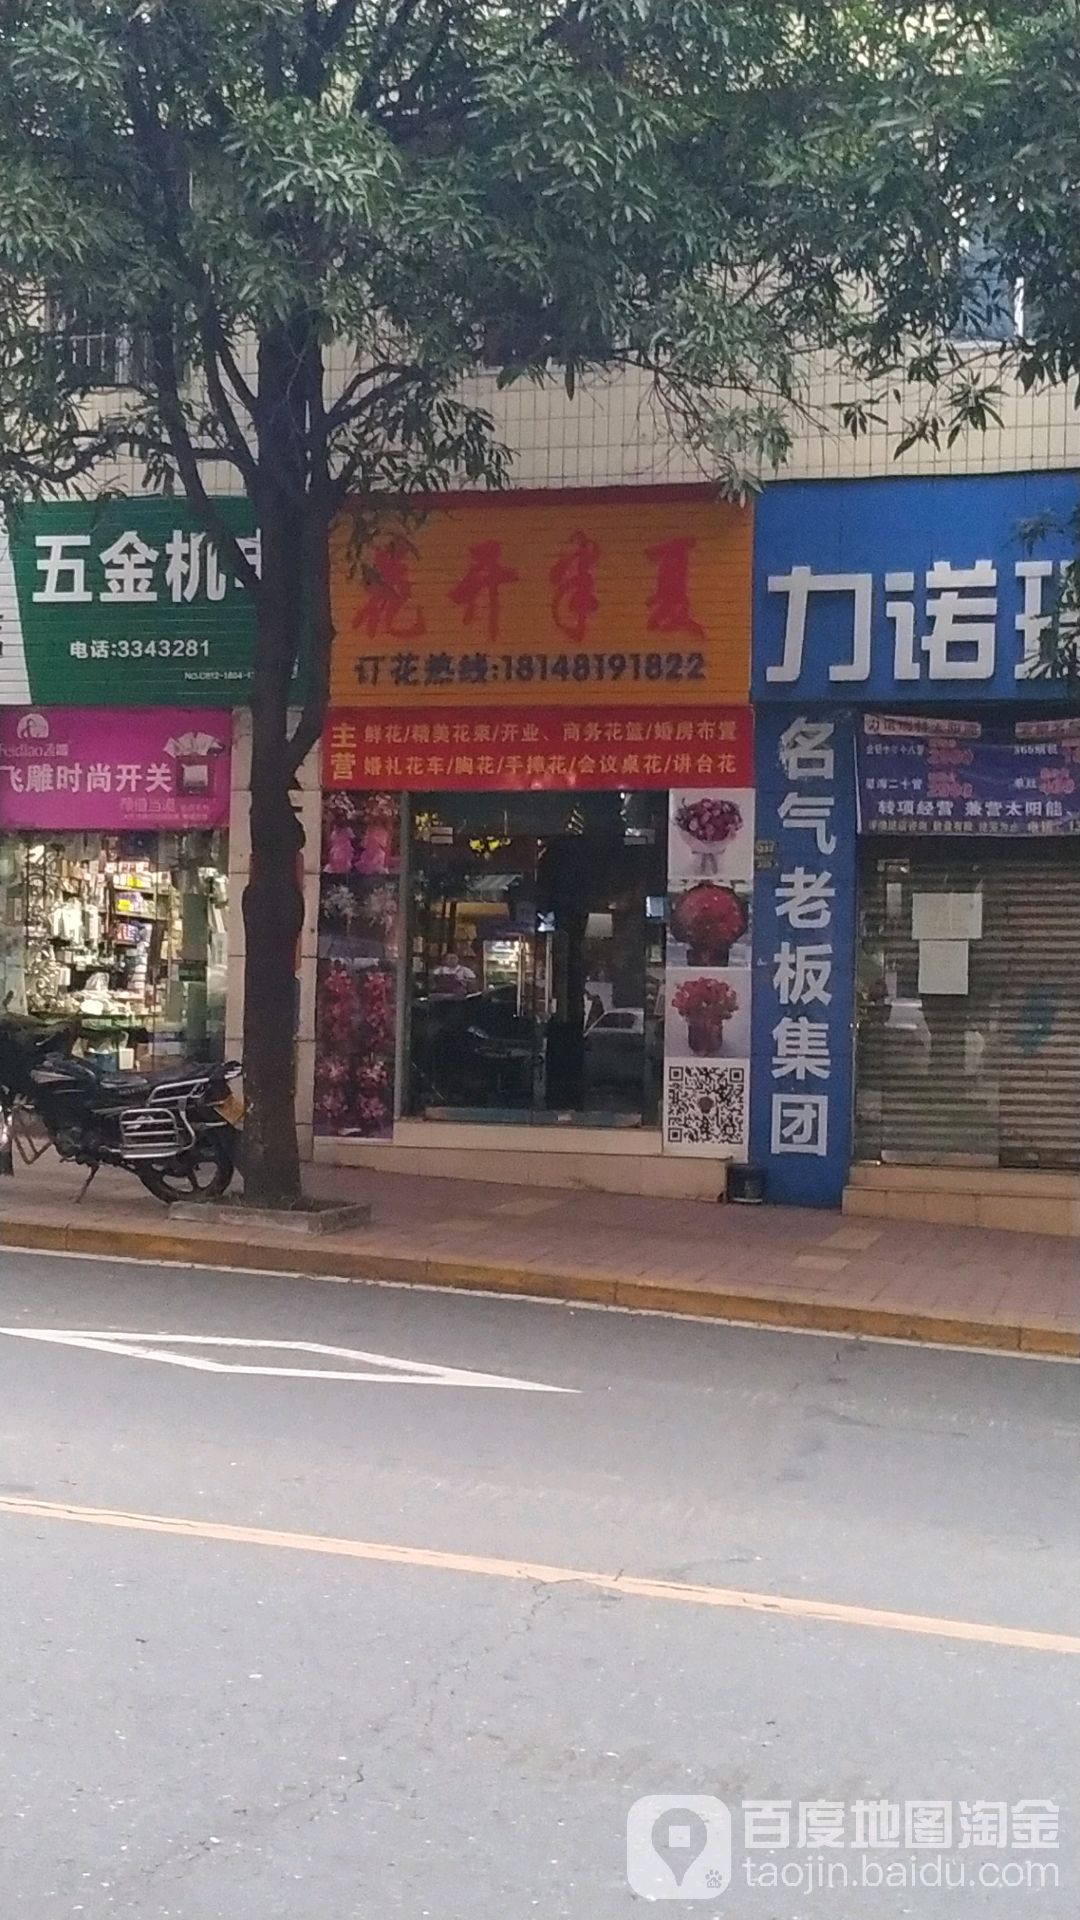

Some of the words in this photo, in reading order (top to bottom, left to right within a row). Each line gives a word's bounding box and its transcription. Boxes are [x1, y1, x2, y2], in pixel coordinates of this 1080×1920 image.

[69, 639, 209, 659] 电话:3343281
[354, 651, 706, 687] 订花热线:18148191822
[331, 722, 357, 781] 主营
[0, 763, 172, 793] 飞雕时尚开关
[770, 716, 836, 1157] 名气老板集团
